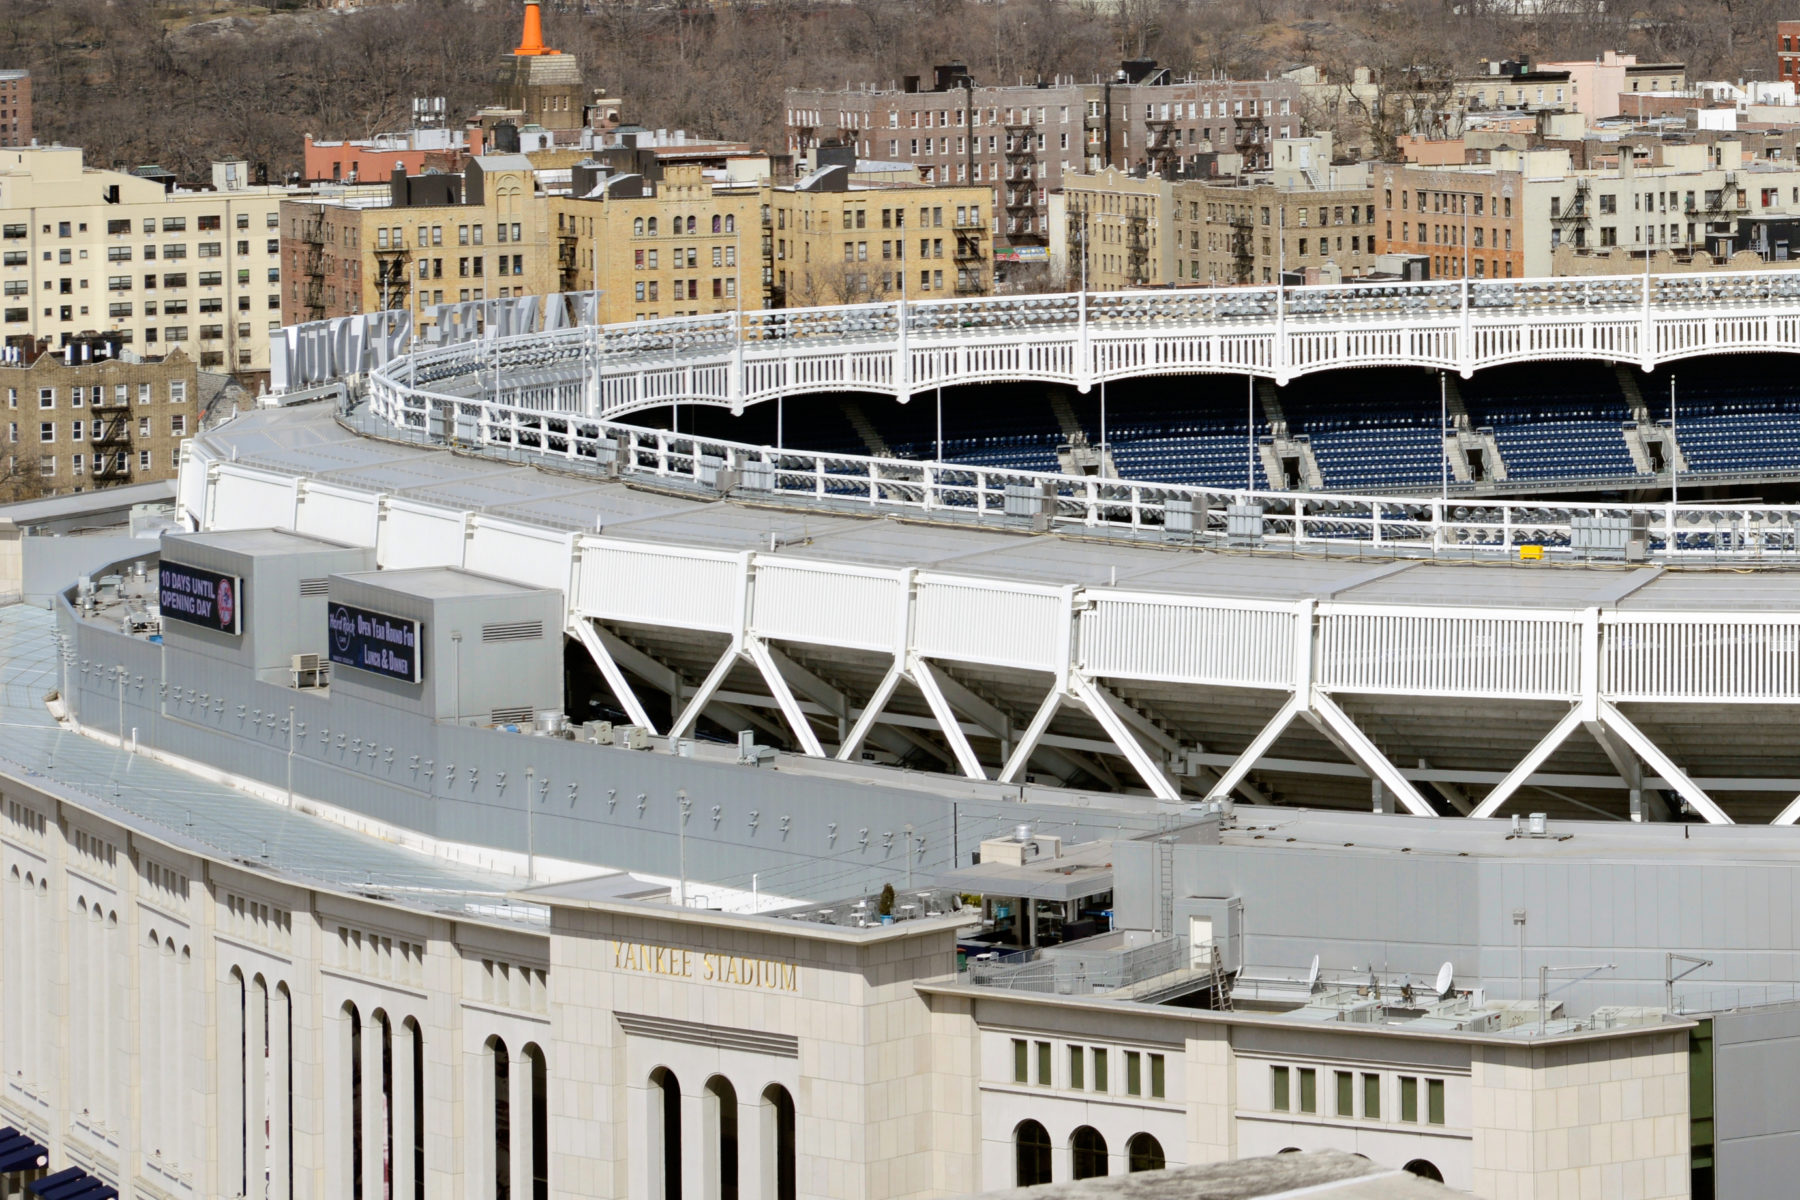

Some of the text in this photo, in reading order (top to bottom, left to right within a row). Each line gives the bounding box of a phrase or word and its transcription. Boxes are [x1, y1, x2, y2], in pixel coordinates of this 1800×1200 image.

[161, 570, 216, 599] 10 DAYS UNTIL
[161, 590, 195, 614] OPENING
[197, 598, 212, 618] DAY
[382, 648, 388, 669] &
[612, 940, 798, 993] YANKEE STADIUM
